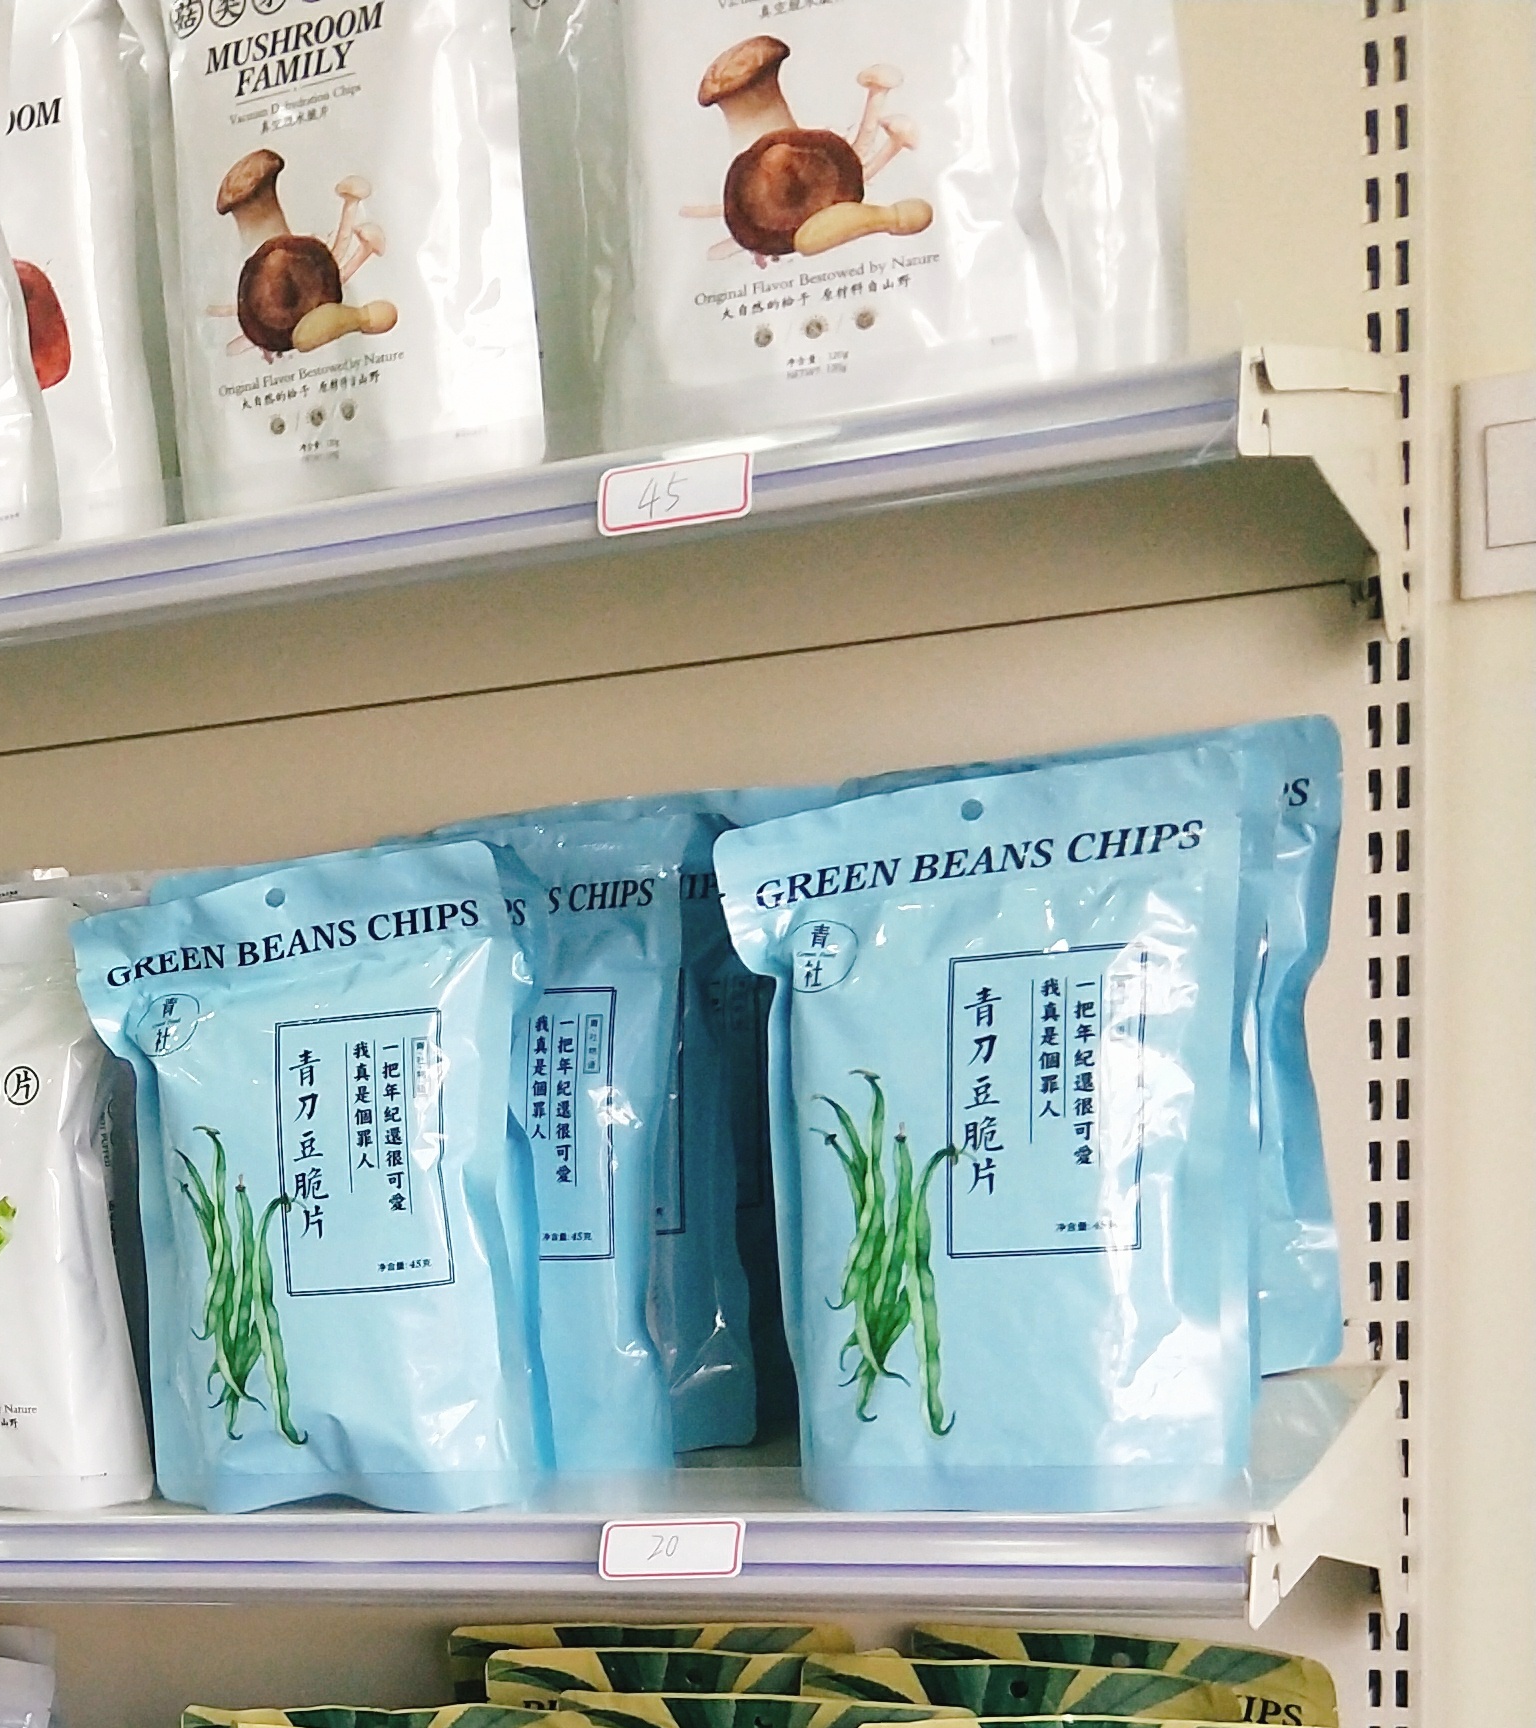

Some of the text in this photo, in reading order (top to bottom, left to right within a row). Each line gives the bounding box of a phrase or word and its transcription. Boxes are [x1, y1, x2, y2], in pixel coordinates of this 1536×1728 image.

[204, 0, 387, 77] MUSHROOM
[234, 40, 357, 98] FAMILY
[693, 249, 940, 307] Original Flavor Bestowed by Nature
[637, 471, 688, 520] 45
[567, 877, 656, 913] CHIPS
[756, 818, 1206, 911] GREEN BEANS CHIPS
[106, 898, 480, 991] GREEN BEANS CHIPS
[529, 1014, 549, 1141] 我真是個罪人
[553, 1017, 574, 1185] 一把年紀還很可愛
[961, 986, 1006, 1196] 青刀豆脆片
[1039, 977, 1062, 1121] 我真是個罪人
[1073, 978, 1096, 1167] 一把年紀還很可愛
[287, 1049, 329, 1240] 青刀豆脆片
[353, 1041, 375, 1170] 我真是個罪人
[382, 1042, 407, 1212] 一把年紀還很可愛
[647, 1535, 680, 1561] 20
